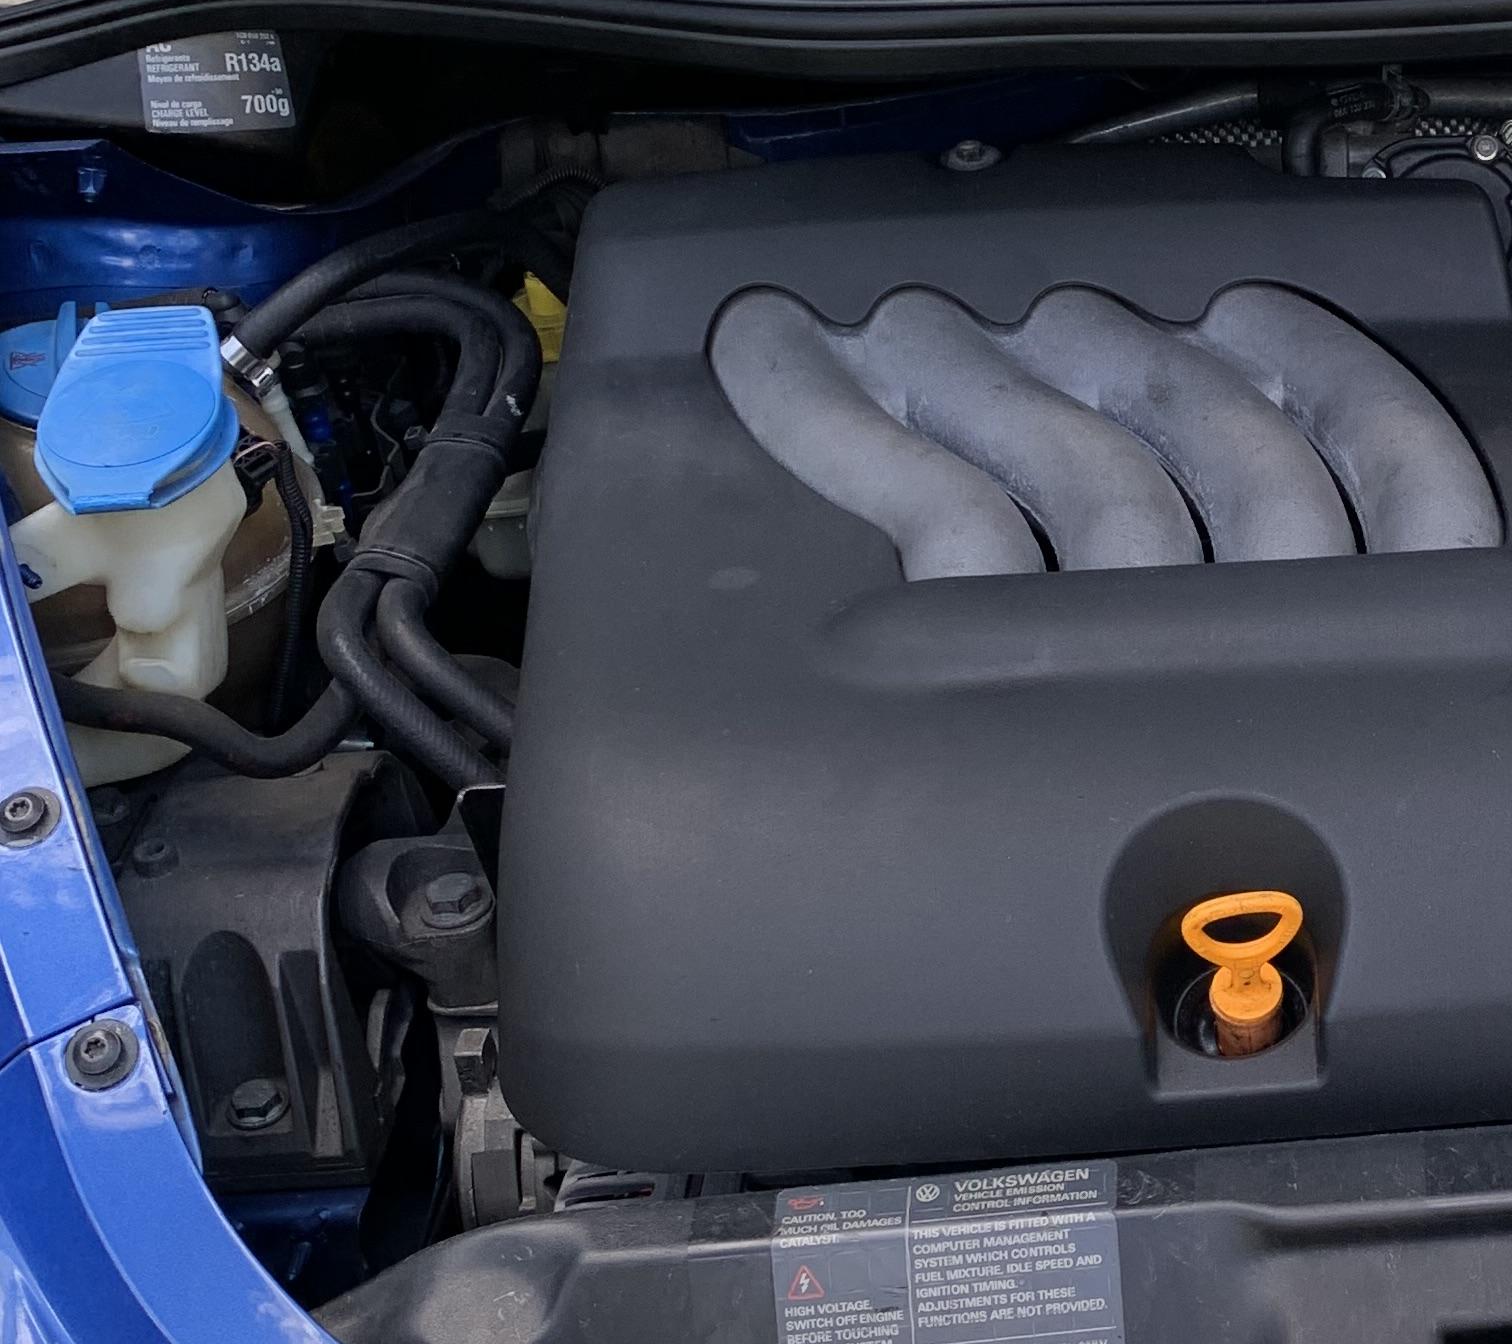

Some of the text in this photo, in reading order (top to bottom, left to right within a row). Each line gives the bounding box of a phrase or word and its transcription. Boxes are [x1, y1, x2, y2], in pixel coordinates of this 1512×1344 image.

[225, 53, 282, 72] R134a
[152, 108, 209, 118] CHARGE LEVEL
[241, 94, 290, 116] 700g
[954, 1168, 1090, 1192] VOLKSWAGEN
[953, 1190, 1098, 1212] CONTROL INFORMATION
[954, 1183, 1065, 1202] VEHICLE EMISSION
[841, 1209, 867, 1219] TOO
[780, 1224, 818, 1235] MUCH
[842, 1216, 902, 1230] DAMAGES
[912, 1212, 1096, 1240] THIS VEHICLE IS FITTED WITH A
[913, 1229, 1071, 1255] COMPUTER MANAGEMENT
[914, 1243, 1076, 1269] SYSTEM WHICH CONTROLS
[915, 1270, 945, 1283] FUEL
[1006, 1260, 1033, 1273] IDLE
[1035, 1257, 1073, 1271] SPEED
[1075, 1254, 1103, 1267] AND
[916, 1279, 1019, 1298] IGNITION TIMING.
[918, 1286, 1076, 1313] ADJUSTMENTS FOR THESE
[785, 1305, 815, 1317] HIGH
[786, 1310, 905, 1331] SWITCH OFF ENGINE
[918, 1298, 1108, 1328] FUNCTIONS ARE NOT PROVIDED.
[787, 1324, 899, 1344] BEFORE TOUCHING
